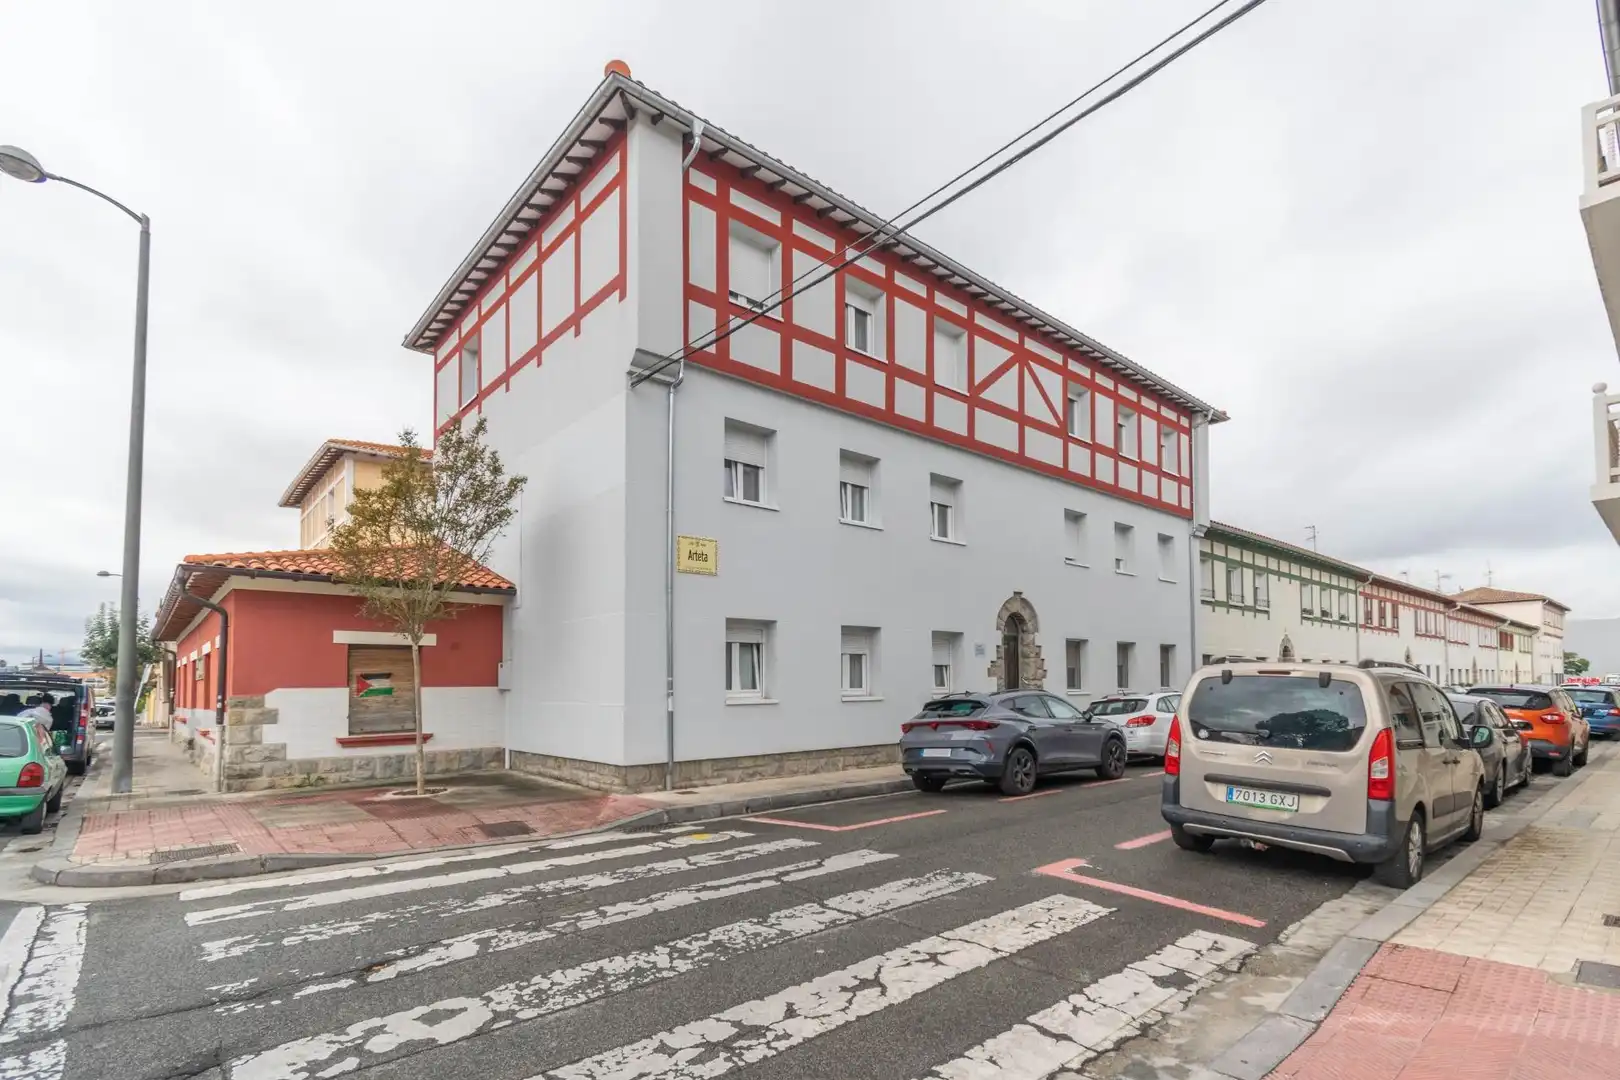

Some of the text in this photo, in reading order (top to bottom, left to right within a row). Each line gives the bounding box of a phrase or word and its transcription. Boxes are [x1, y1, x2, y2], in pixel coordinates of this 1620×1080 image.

[687, 550, 709, 562] Arteta
[1235, 789, 1295, 807] 7013 GXJ
